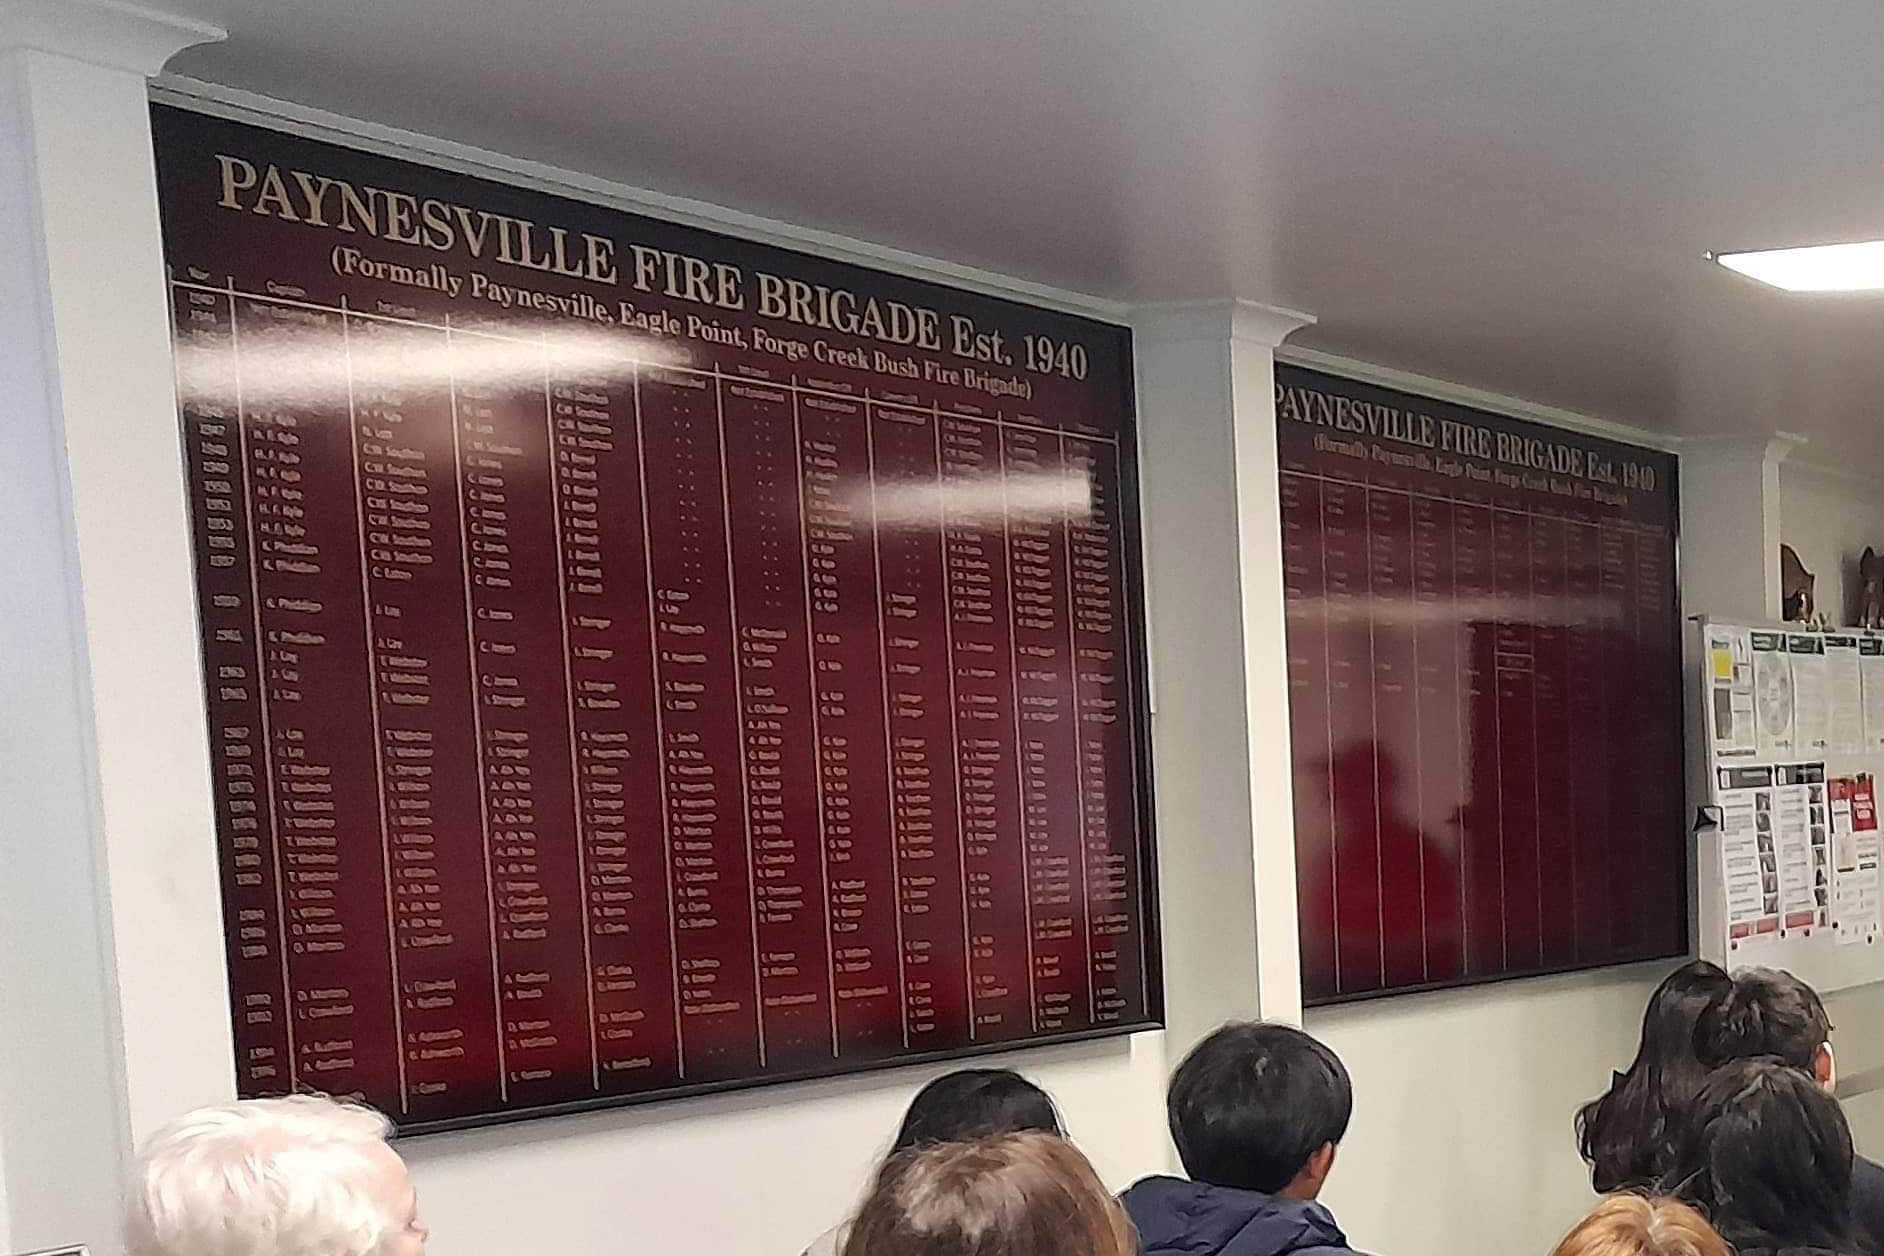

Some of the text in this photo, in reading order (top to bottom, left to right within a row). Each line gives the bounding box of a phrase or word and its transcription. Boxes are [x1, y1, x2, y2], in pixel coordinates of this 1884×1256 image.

[215, 154, 1088, 380] PAYNESVILLE FIRE BRIGADE Est. 1940
[331, 246, 462, 297] (Formally
[618, 302, 681, 337] Eagle
[687, 315, 748, 350] Point,
[752, 327, 809, 361] Forge
[813, 340, 870, 370] Creek
[873, 351, 920, 379] Bush
[924, 361, 960, 385] Fire
[963, 367, 1033, 400] Brigade)
[1440, 420, 1492, 460] FIRE
[1497, 432, 1584, 478] BRIGADE
[1621, 461, 1656, 492] 1940
